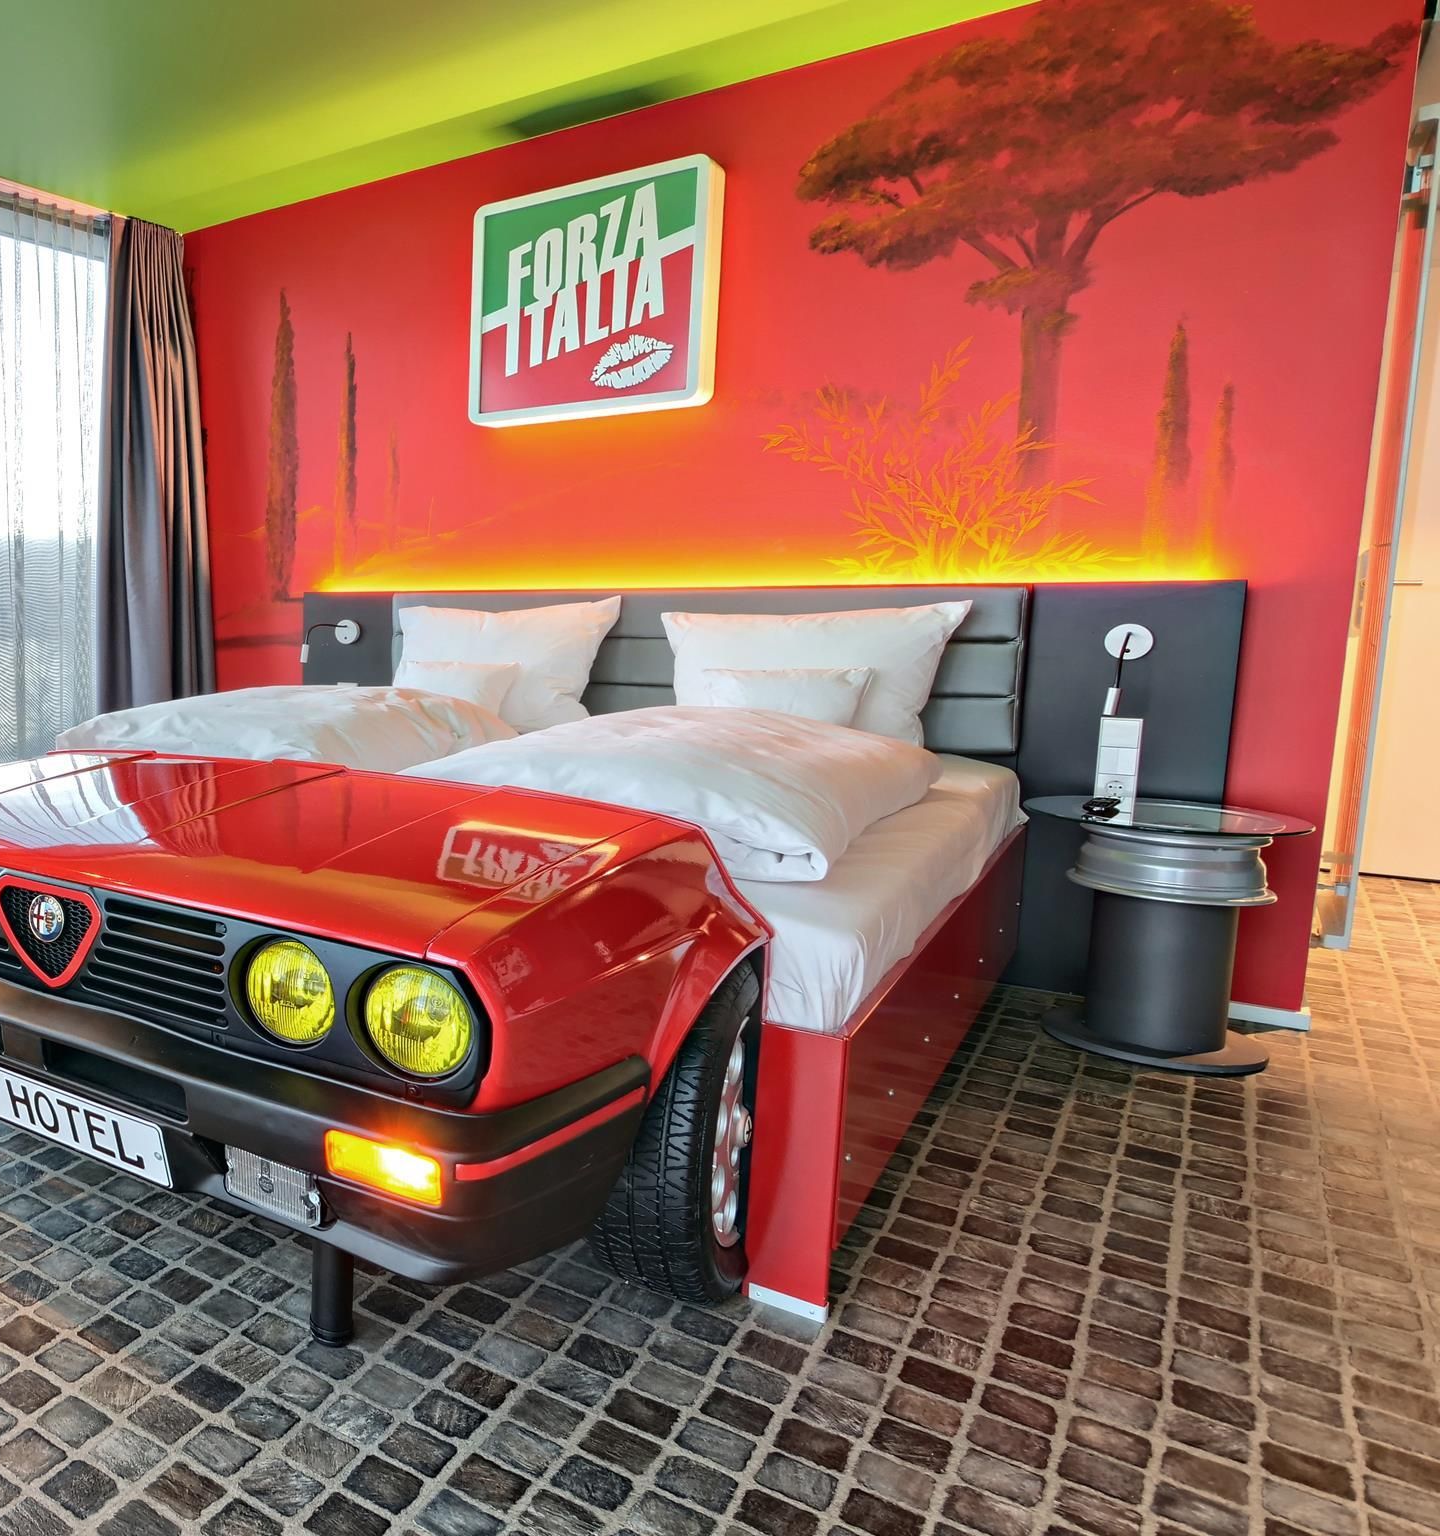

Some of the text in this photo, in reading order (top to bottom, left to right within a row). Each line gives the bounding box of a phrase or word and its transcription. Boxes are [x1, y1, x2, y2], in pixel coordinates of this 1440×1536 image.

[508, 181, 660, 308] FORZA
[505, 252, 665, 378] ITALIA
[5, 1078, 146, 1170] HOTEL
